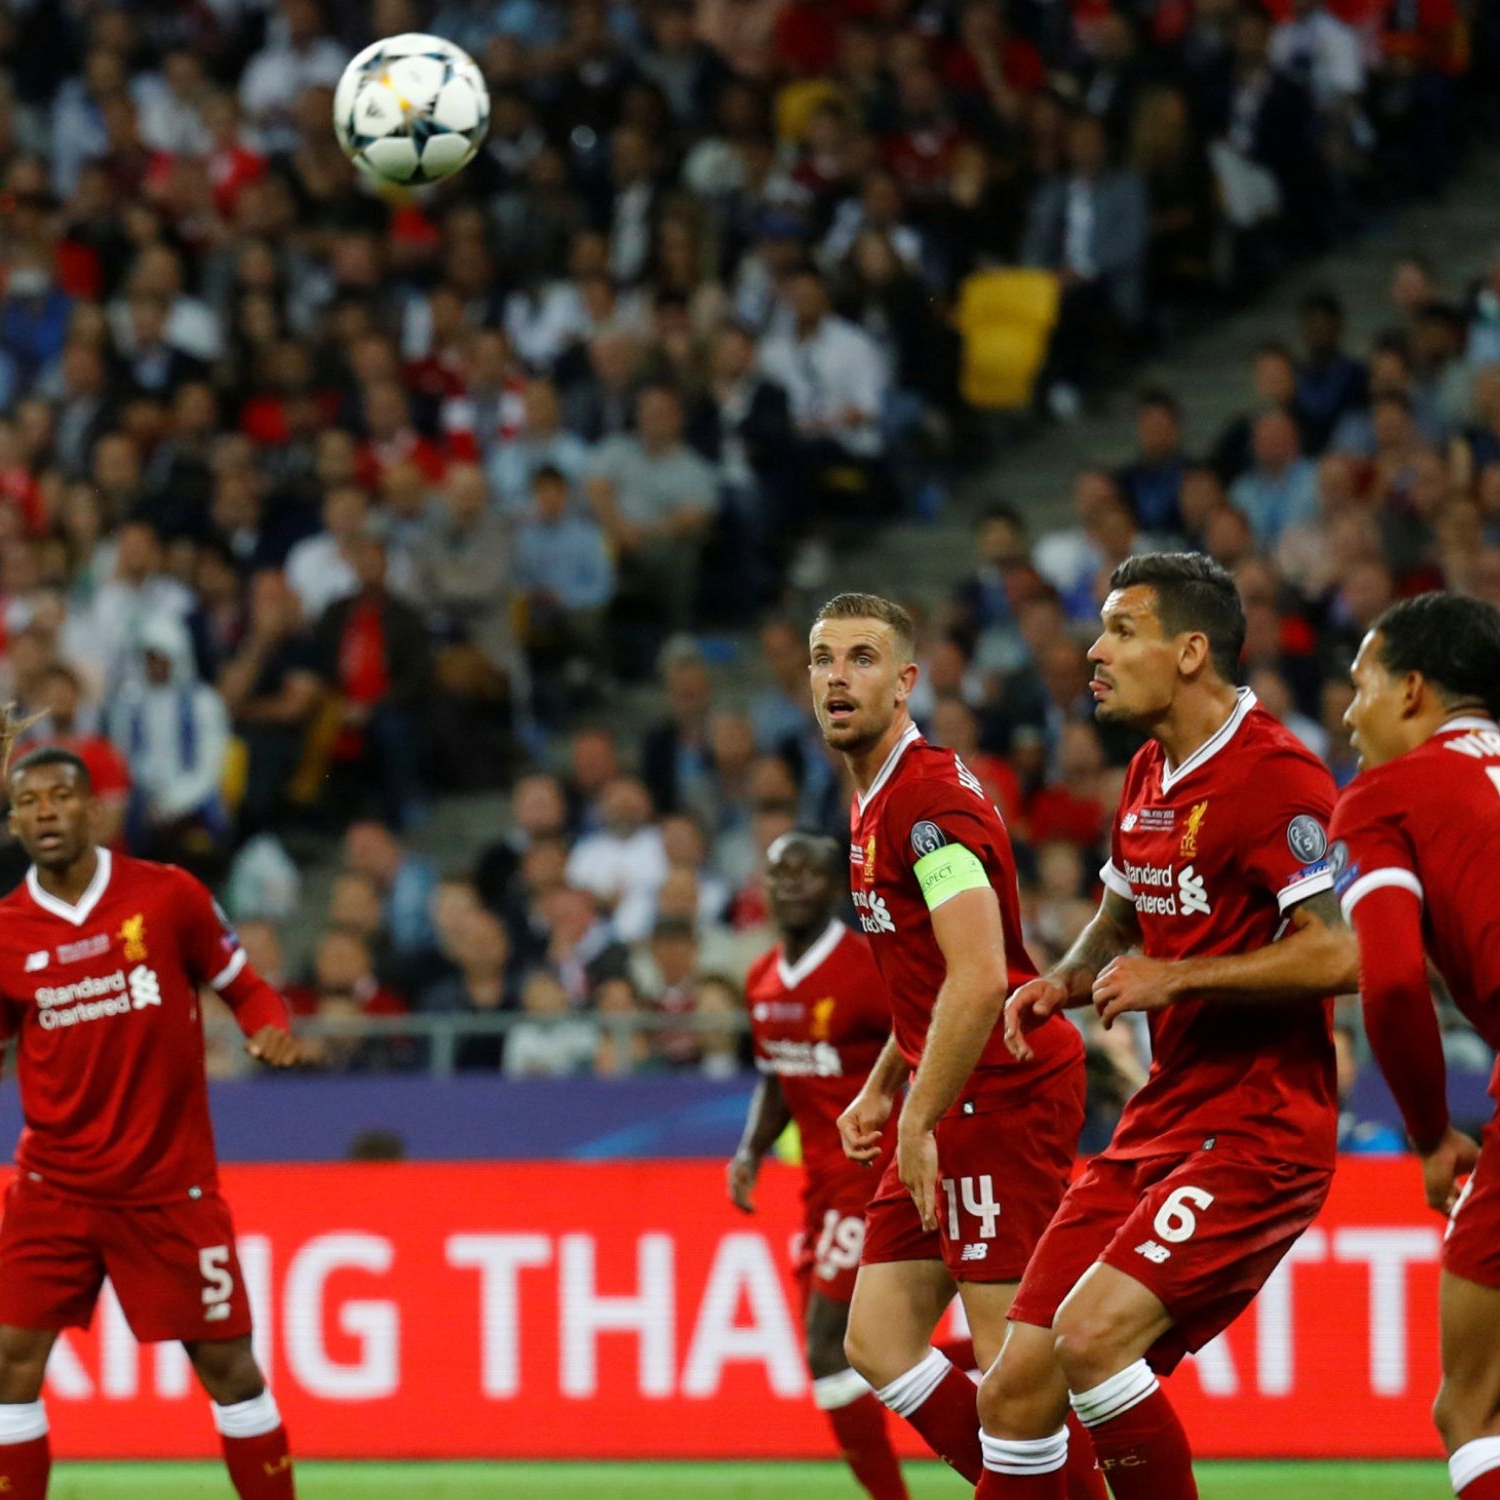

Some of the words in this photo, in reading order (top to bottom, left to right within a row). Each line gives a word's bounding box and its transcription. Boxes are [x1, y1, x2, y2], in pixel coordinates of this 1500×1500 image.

[35, 969, 126, 1009] Standard
[38, 991, 131, 1030] Chartered
[942, 1175, 1001, 1240] 14
[1153, 1185, 1215, 1243] 6
[814, 1209, 866, 1269] 19
[198, 1244, 234, 1305] 5
[445, 1230, 812, 1400] THA
